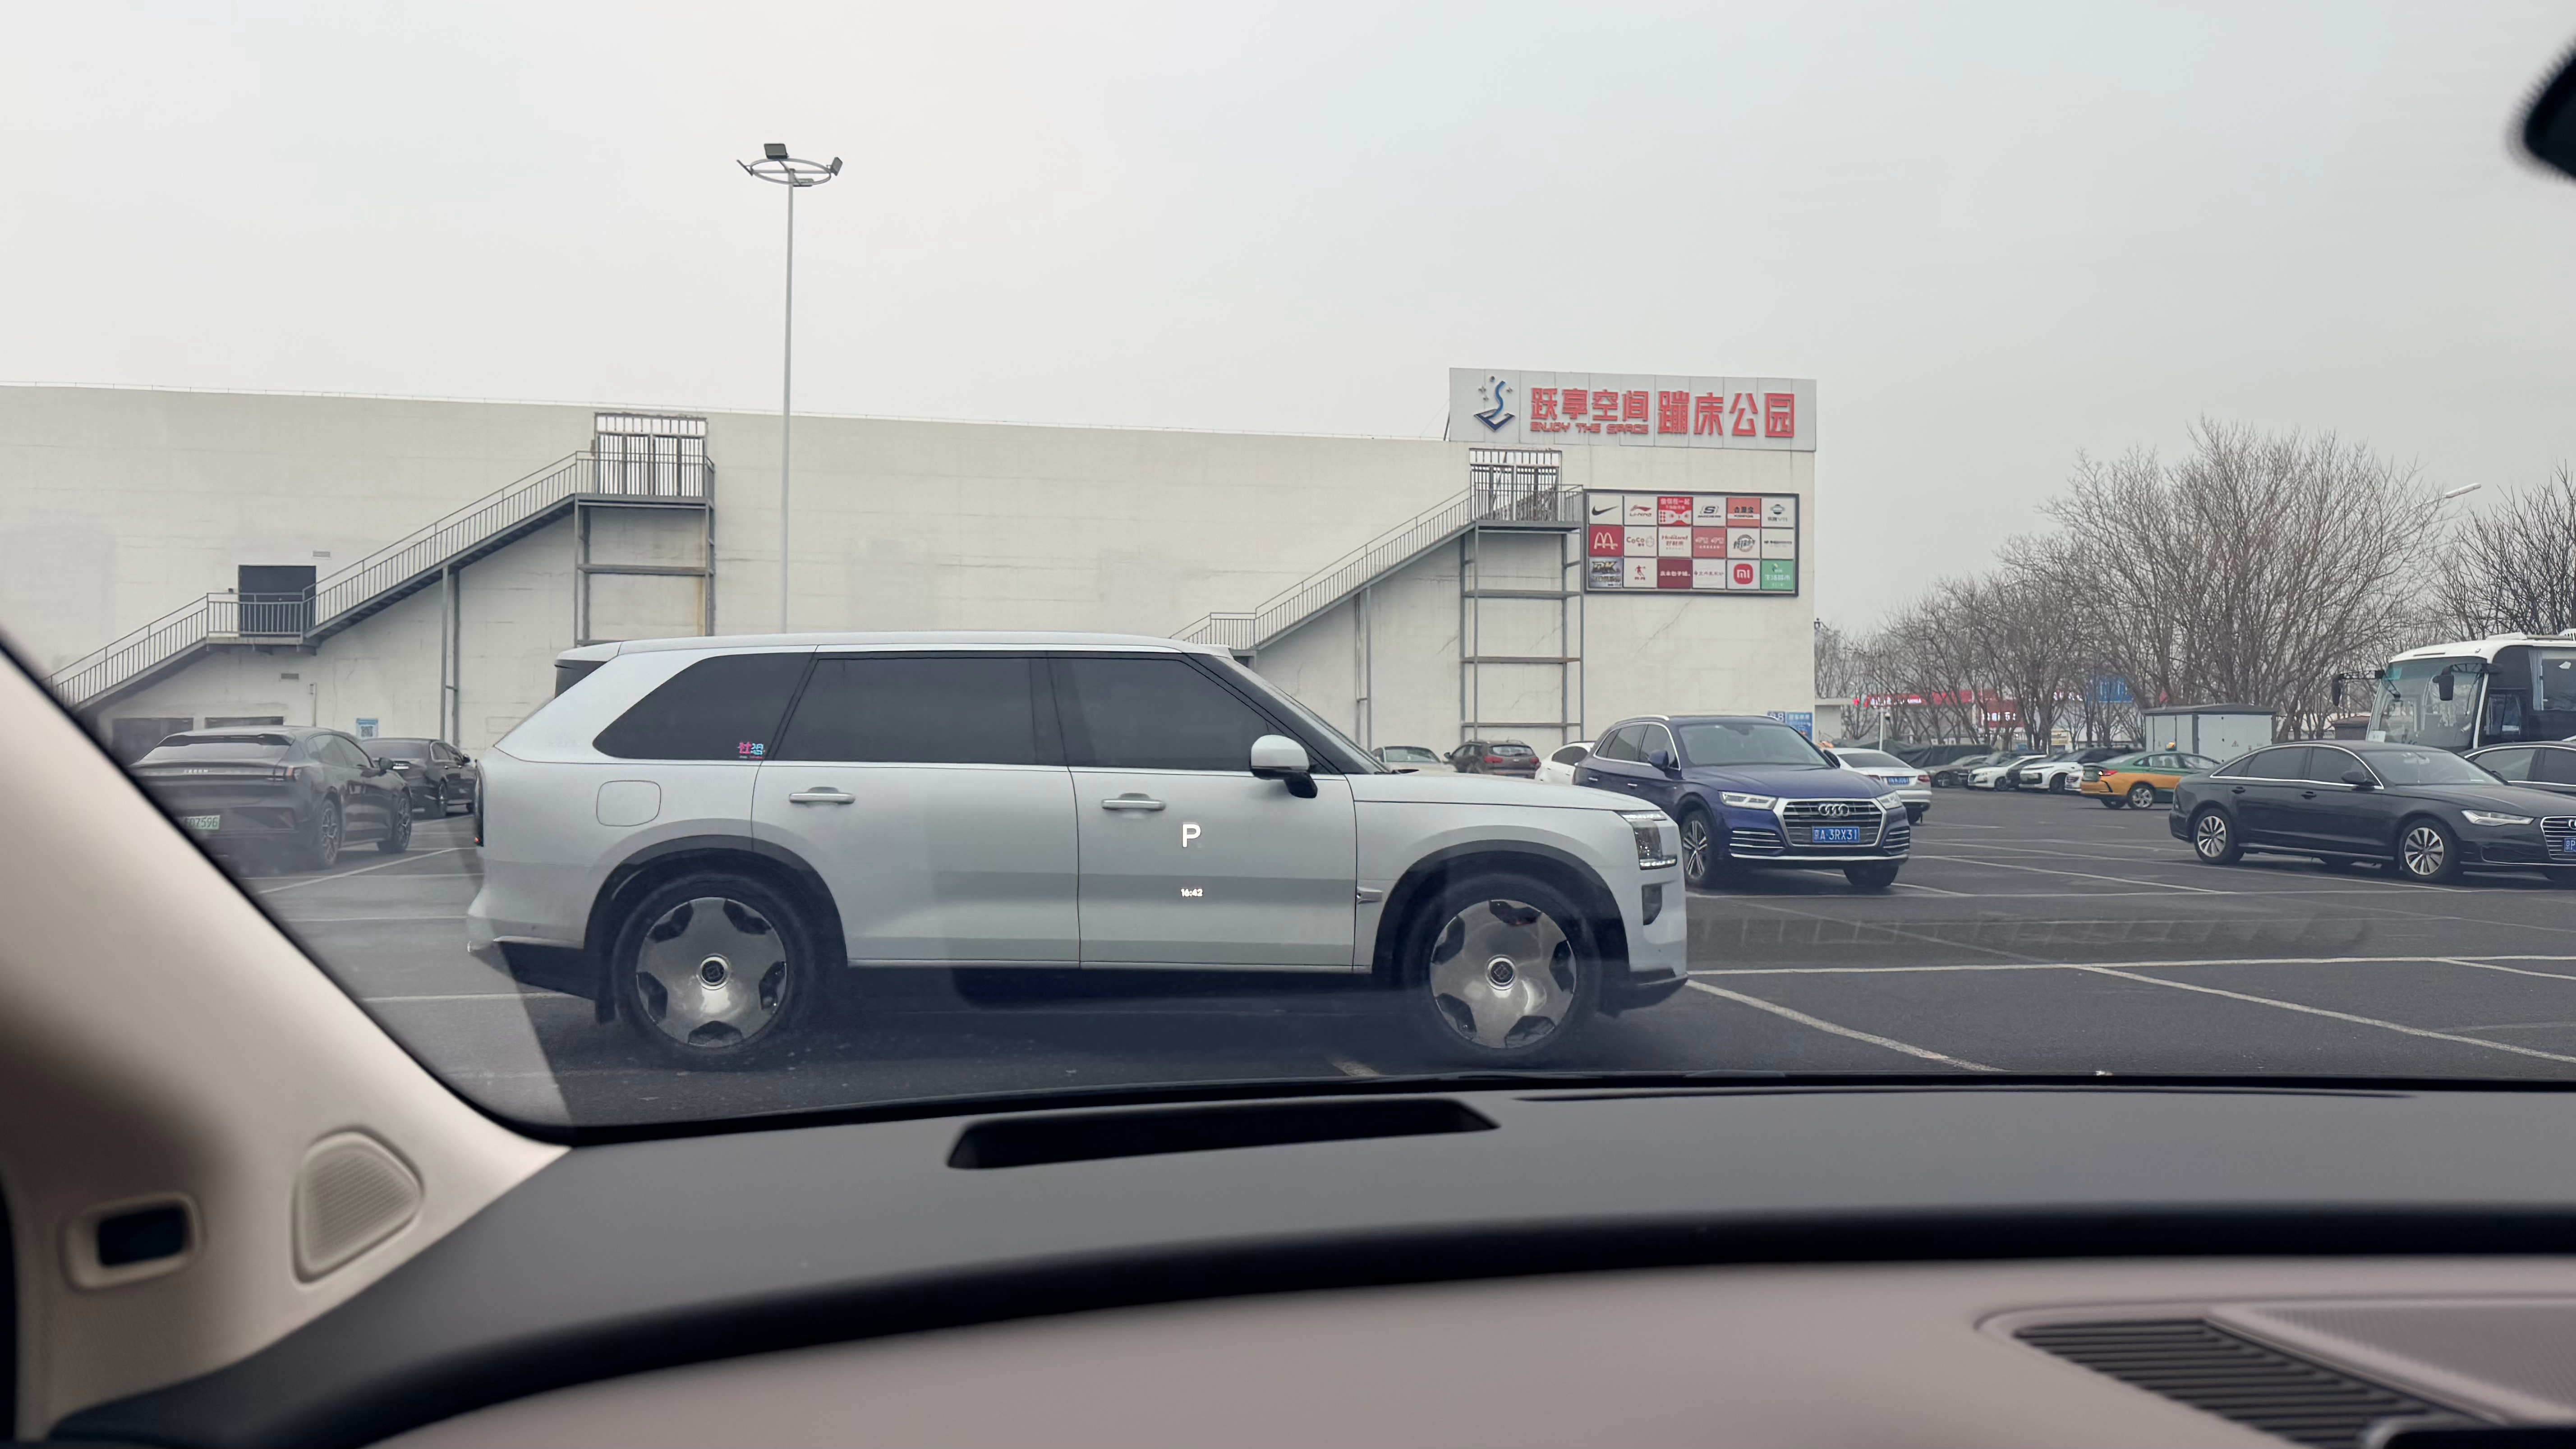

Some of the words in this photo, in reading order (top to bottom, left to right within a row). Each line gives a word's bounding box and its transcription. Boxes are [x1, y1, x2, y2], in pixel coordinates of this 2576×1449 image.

[1531, 387, 1649, 421] 跃享空间
[1657, 391, 1795, 437] 蹦床公园
[1530, 422, 1570, 432] ENJOY
[1575, 423, 1601, 433] THE
[1606, 423, 1648, 434] SPACE
[1182, 824, 1201, 847] P
[1181, 888, 1203, 897] 16:42
